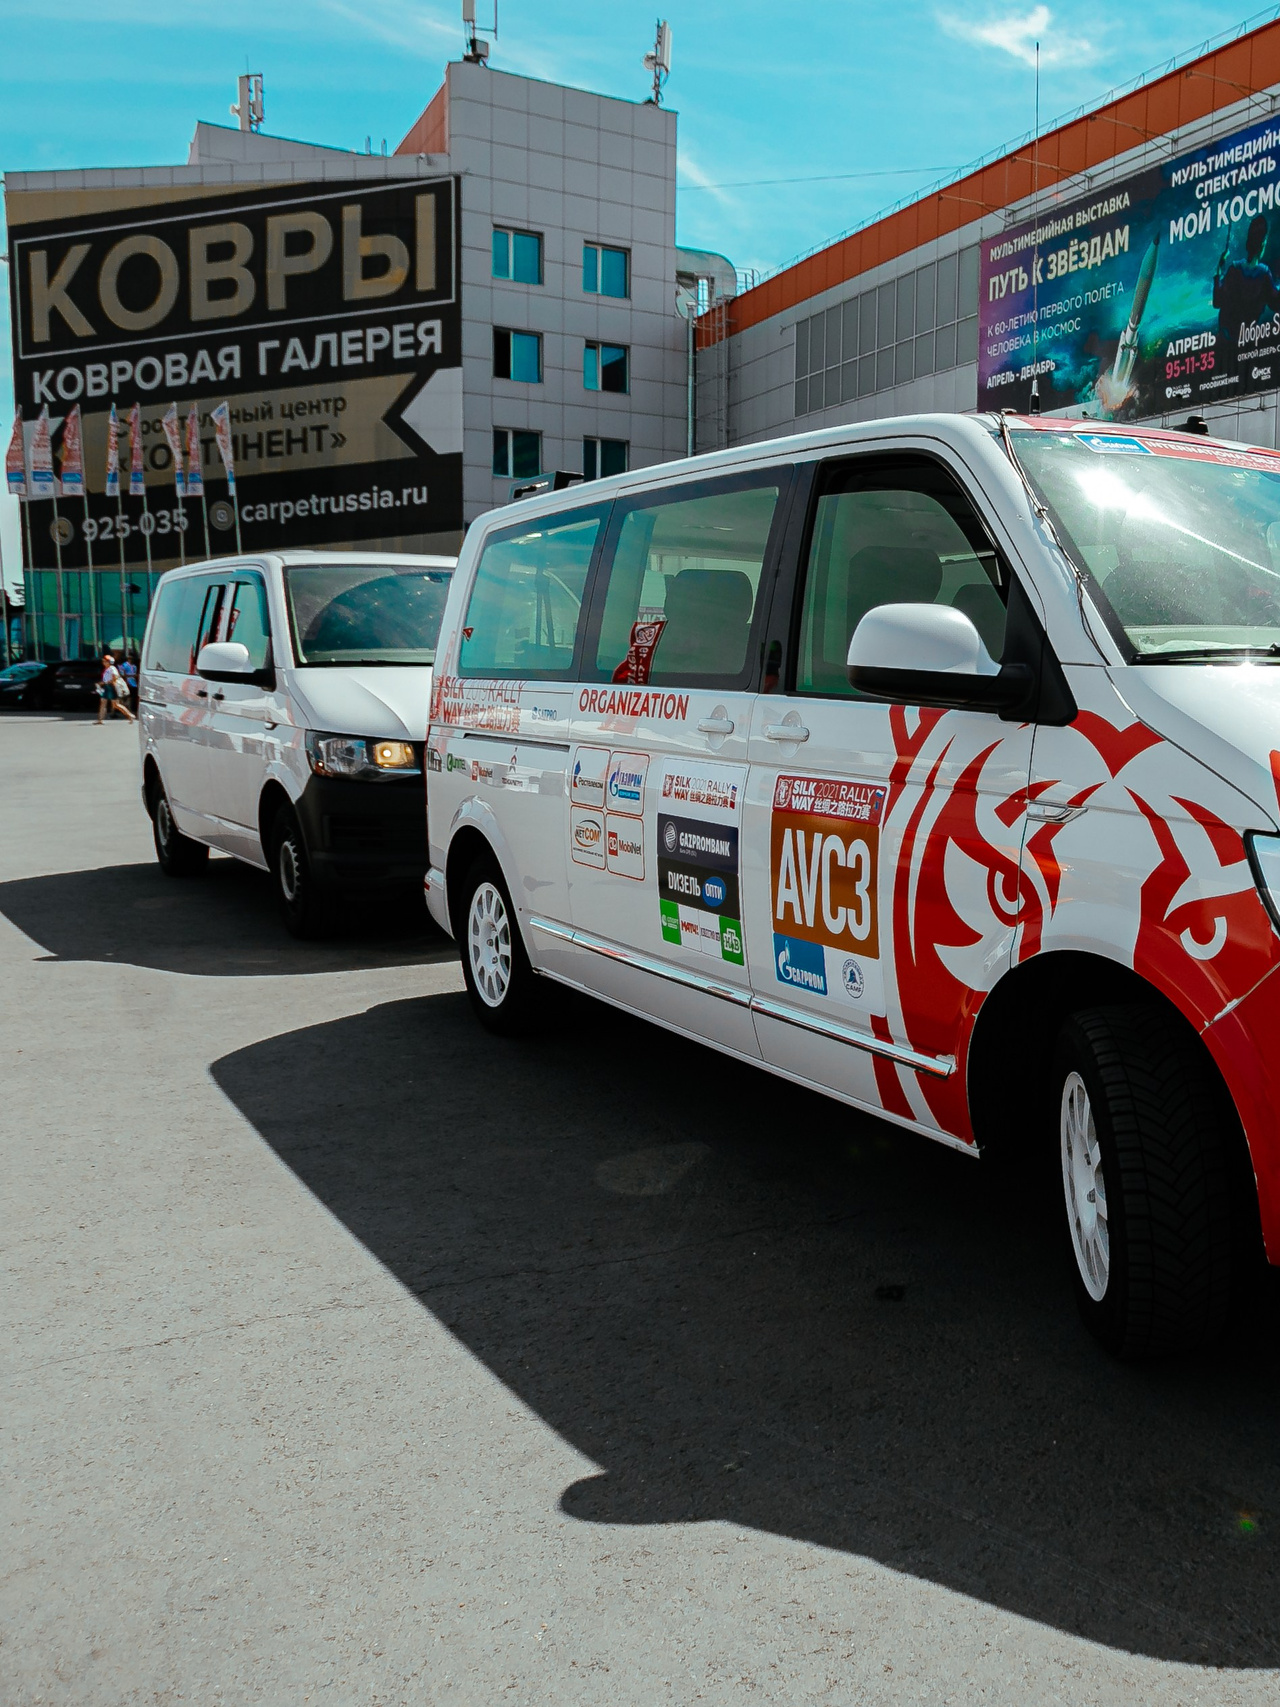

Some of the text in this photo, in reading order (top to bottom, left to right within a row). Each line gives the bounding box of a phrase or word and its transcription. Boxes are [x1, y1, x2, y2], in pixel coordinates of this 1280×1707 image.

[1195, 156, 1276, 199] СПЕКТАКЛЬ
[989, 192, 1130, 262] МУЛЬТИМЕДИЙНАЯ ВЫСТАВКА
[1169, 201, 1211, 244] МОЙ
[28, 193, 437, 343] КОВРЫ
[988, 225, 1130, 302] ПУТЬ К ЗВЁЗДАМ
[987, 281, 1124, 338] К 60-ЛЕТИЮ ПЕРВОГО ПОЛЁТА
[987, 334, 1031, 357] ЧЕЛОВЕКА
[1041, 317, 1081, 340] КОСМОС
[1166, 331, 1217, 357] АПРЕЛЬ
[1237, 320, 1271, 347] Доброе
[32, 319, 443, 403] КОВРОВАЯ ГАЛЕРЕЯ
[987, 371, 1015, 389] АПРЕЛЬ
[1020, 359, 1056, 381] ДЕКАБРЬ
[1165, 351, 1215, 379] 95-11-35
[281, 397, 347, 420] центр
[1145, 440, 1252, 462] INTERNATIONAL
[241, 484, 428, 527] carpetrussia.ru
[82, 508, 189, 541] 925-035
[443, 676, 466, 699] SILK
[488, 680, 527, 703] RALLY
[442, 701, 463, 725] WAY
[579, 689, 690, 720] ORGANIZATION
[674, 775, 732, 795] SILK 2021 RALLY
[674, 787, 689, 800] WAY
[792, 780, 875, 804] SILK 2021 RALLY
[791, 797, 815, 811] WAY
[618, 840, 642, 856] MobiNet
[679, 832, 731, 857] GAZPROMBANK
[704, 883, 723, 900] ОПТИ
[776, 828, 871, 941] AVC3
[723, 928, 741, 953] НТВ
[791, 967, 825, 992] GAZPROM
